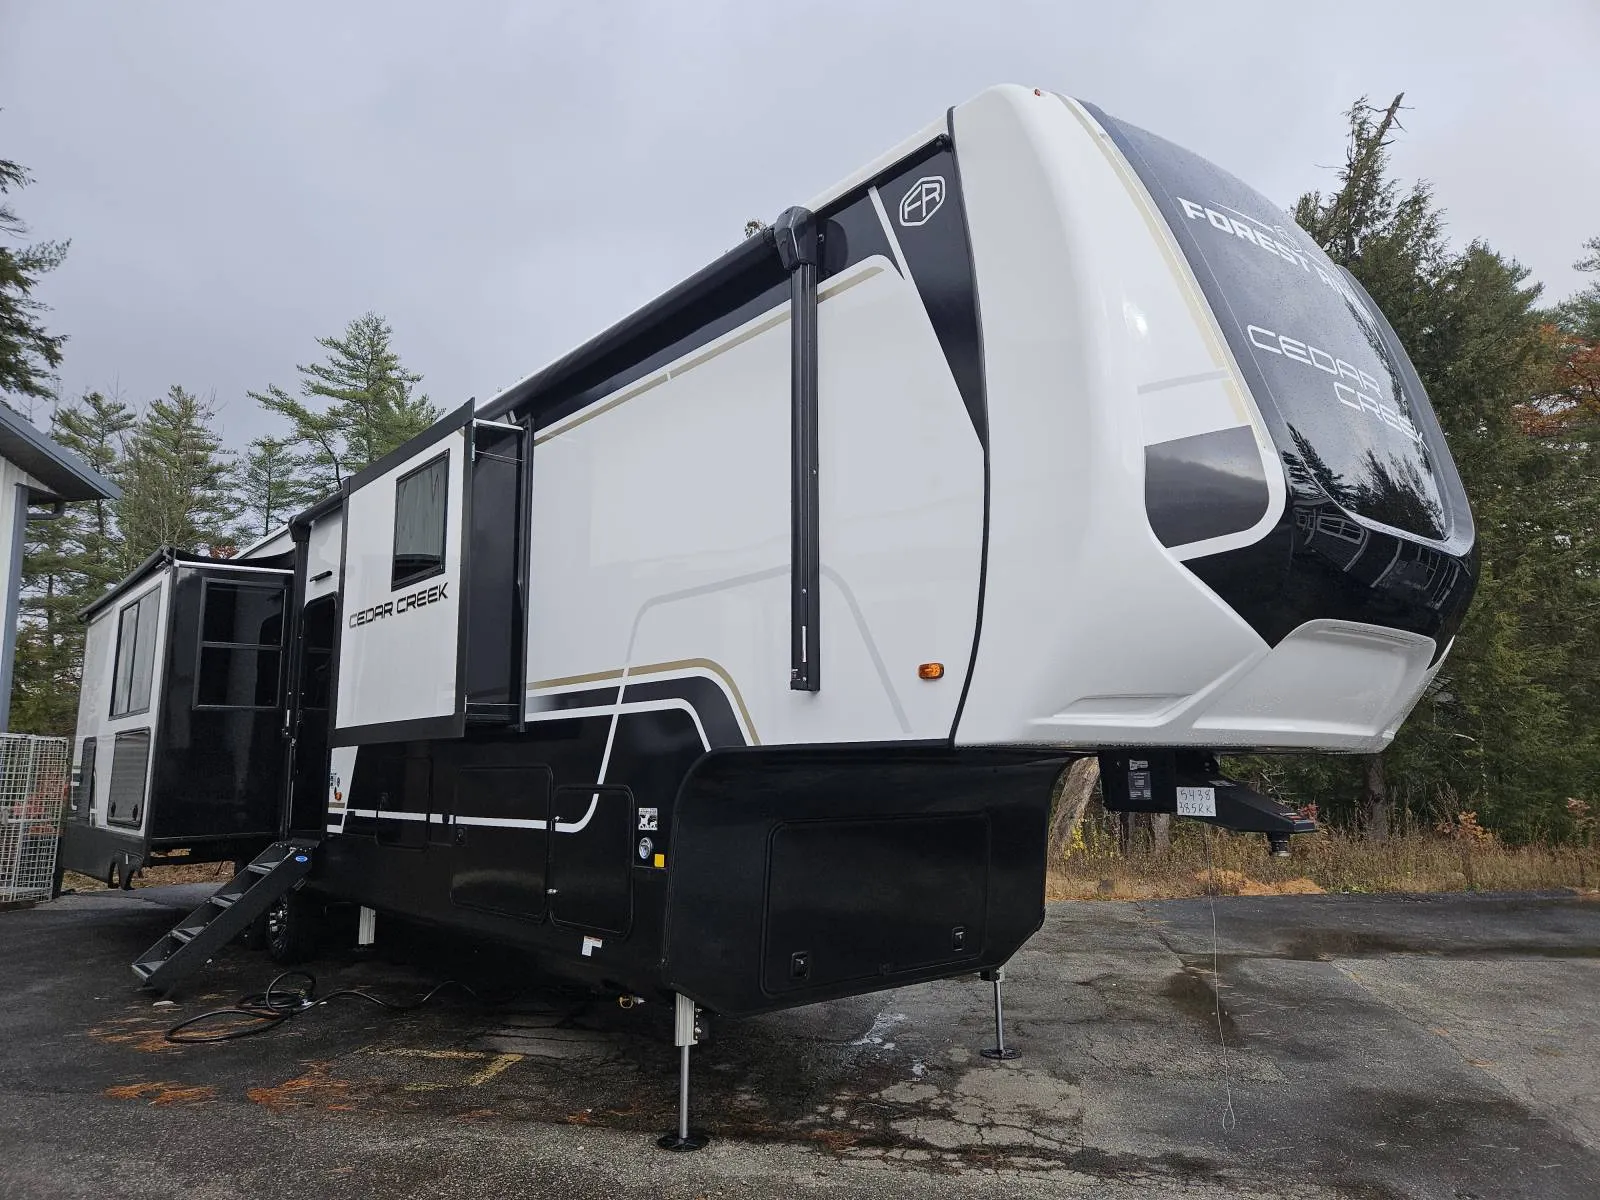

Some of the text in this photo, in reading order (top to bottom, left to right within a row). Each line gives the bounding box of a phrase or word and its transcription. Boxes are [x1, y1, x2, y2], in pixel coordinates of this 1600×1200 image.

[1176, 196, 1311, 273] FOREST
[1247, 324, 1383, 399] CEDAR
[1333, 381, 1430, 452] CREEK
[349, 582, 449, 629] CEDAR CREEK
[1180, 789, 1211, 801] 5438
